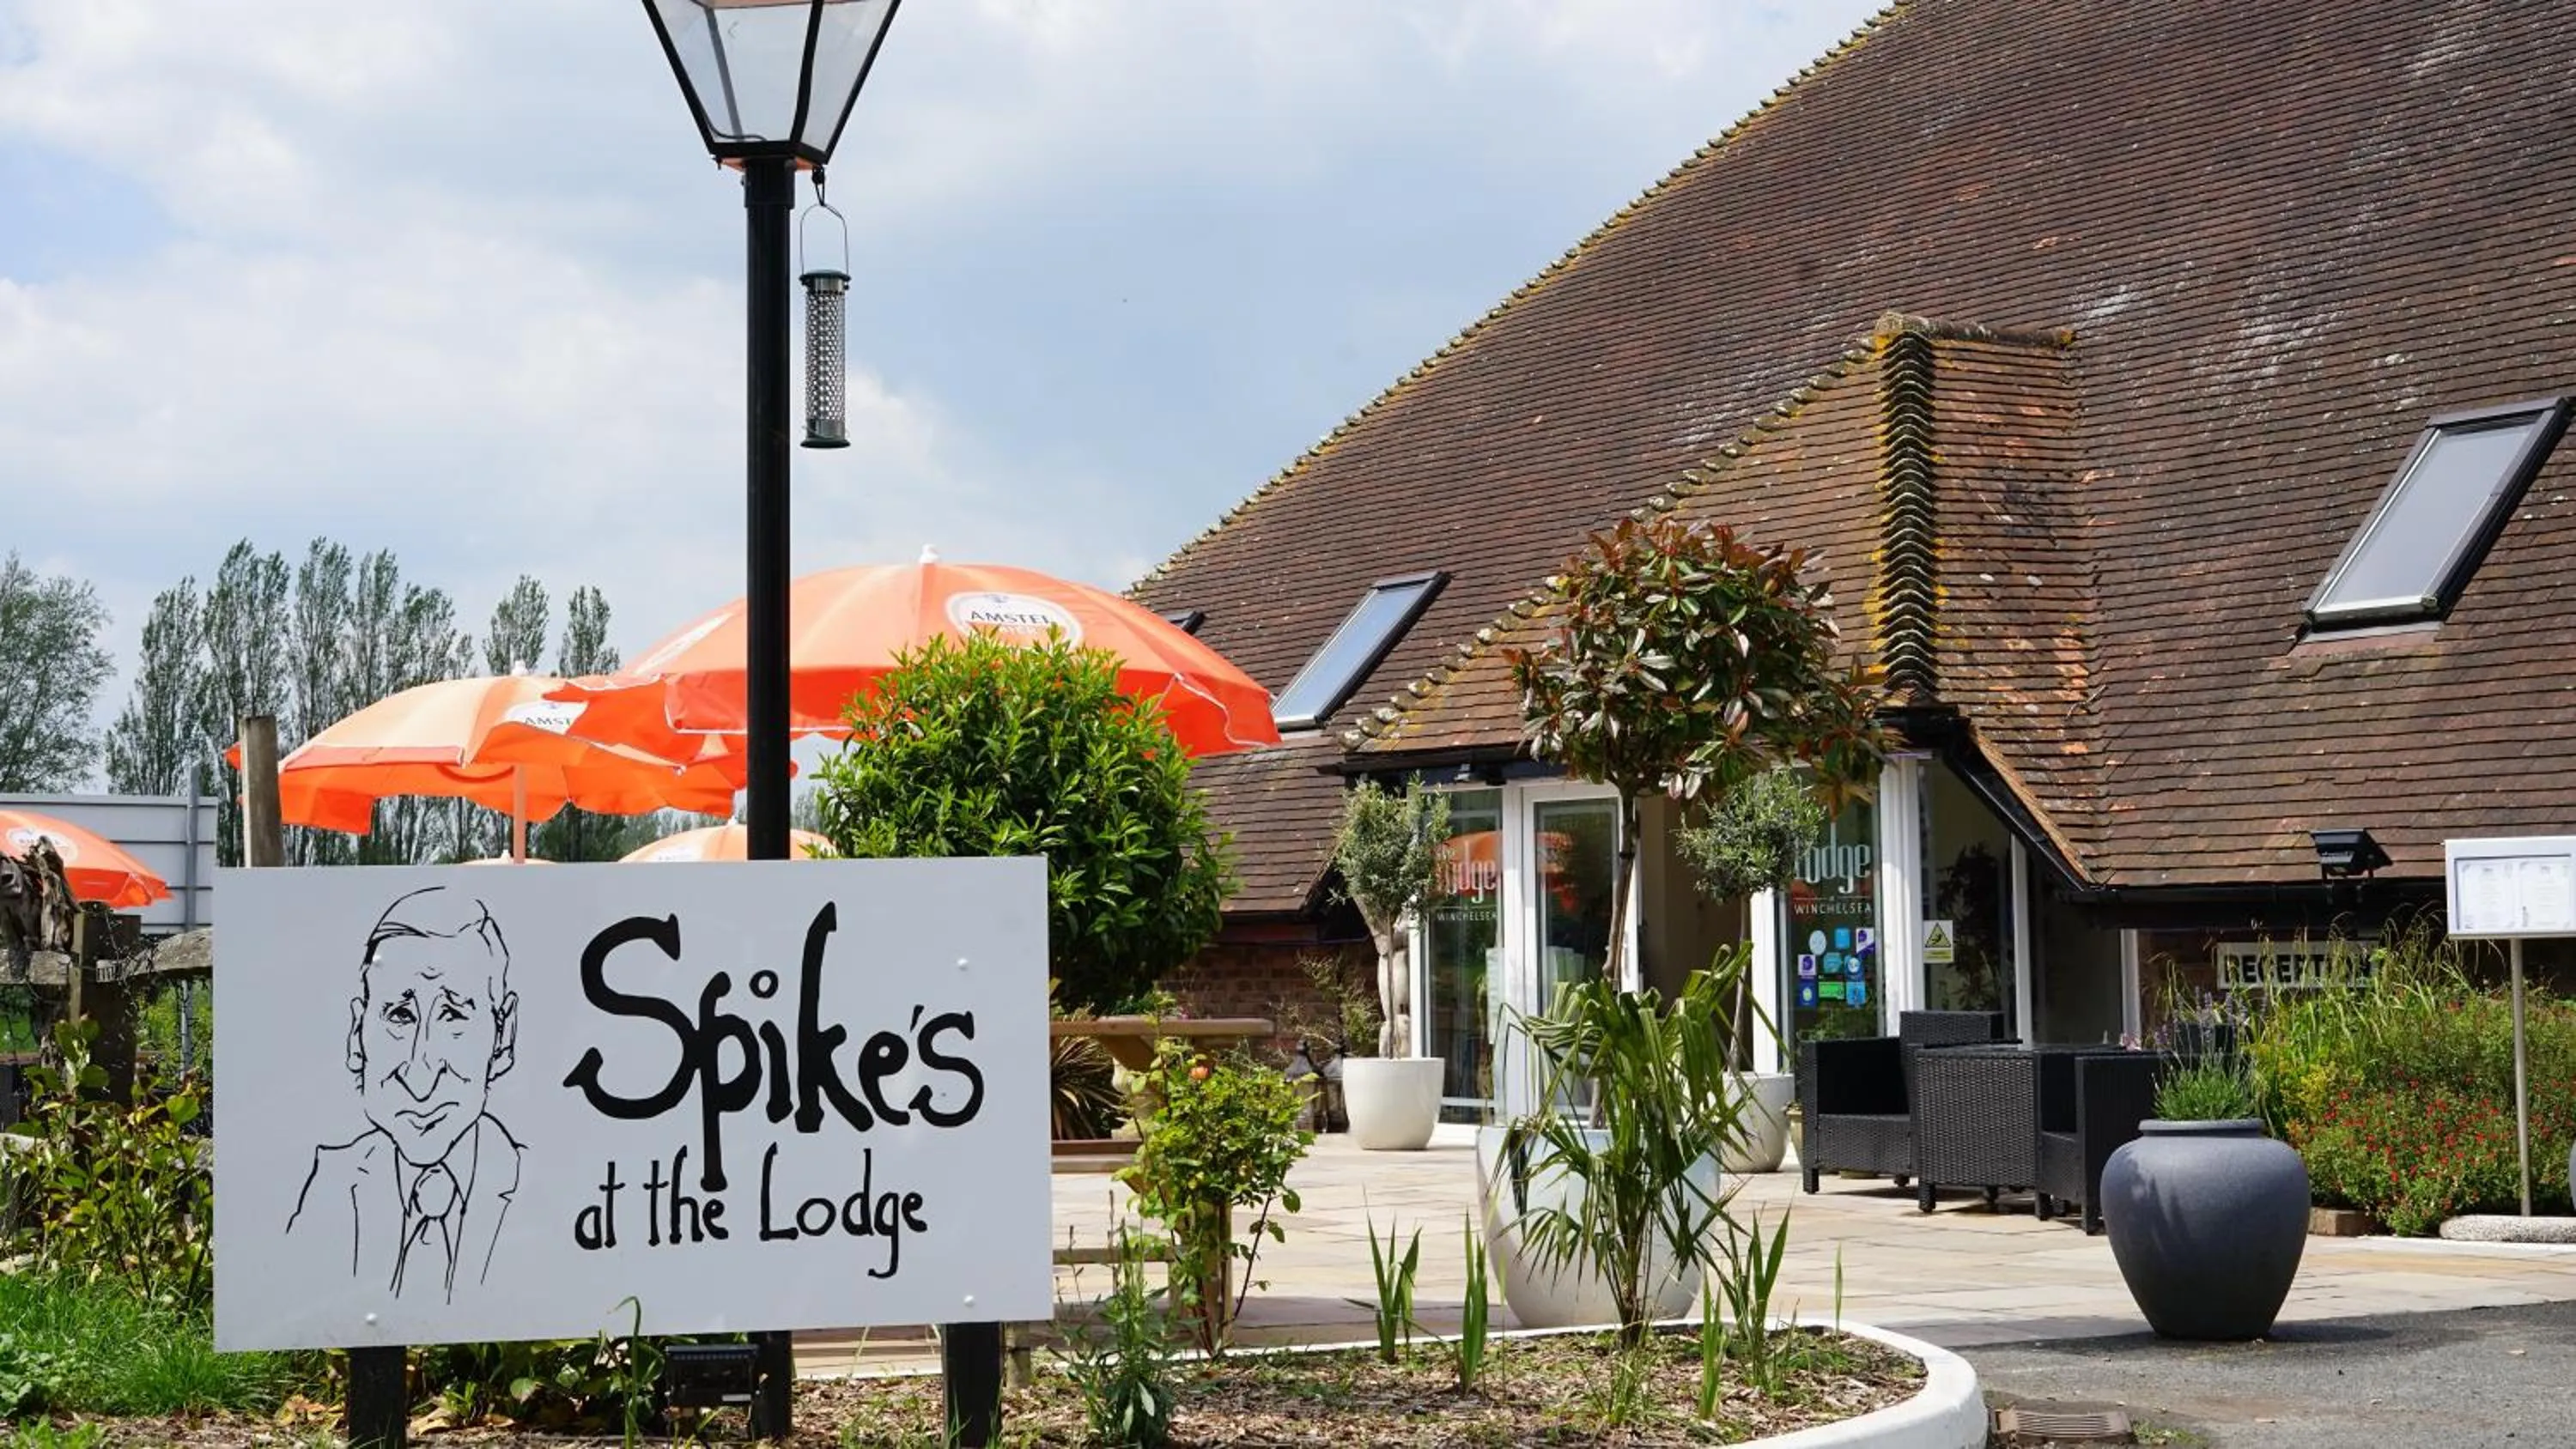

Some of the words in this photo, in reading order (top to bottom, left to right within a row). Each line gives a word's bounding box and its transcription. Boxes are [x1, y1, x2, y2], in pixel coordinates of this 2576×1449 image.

[525, 717, 571, 726] AMST
[1794, 902, 1871, 915] WINCHELSEA
[562, 901, 985, 1193] Spike's
[574, 1161, 626, 1251] at
[642, 1144, 729, 1247] the
[759, 1142, 928, 1279] Lodge
